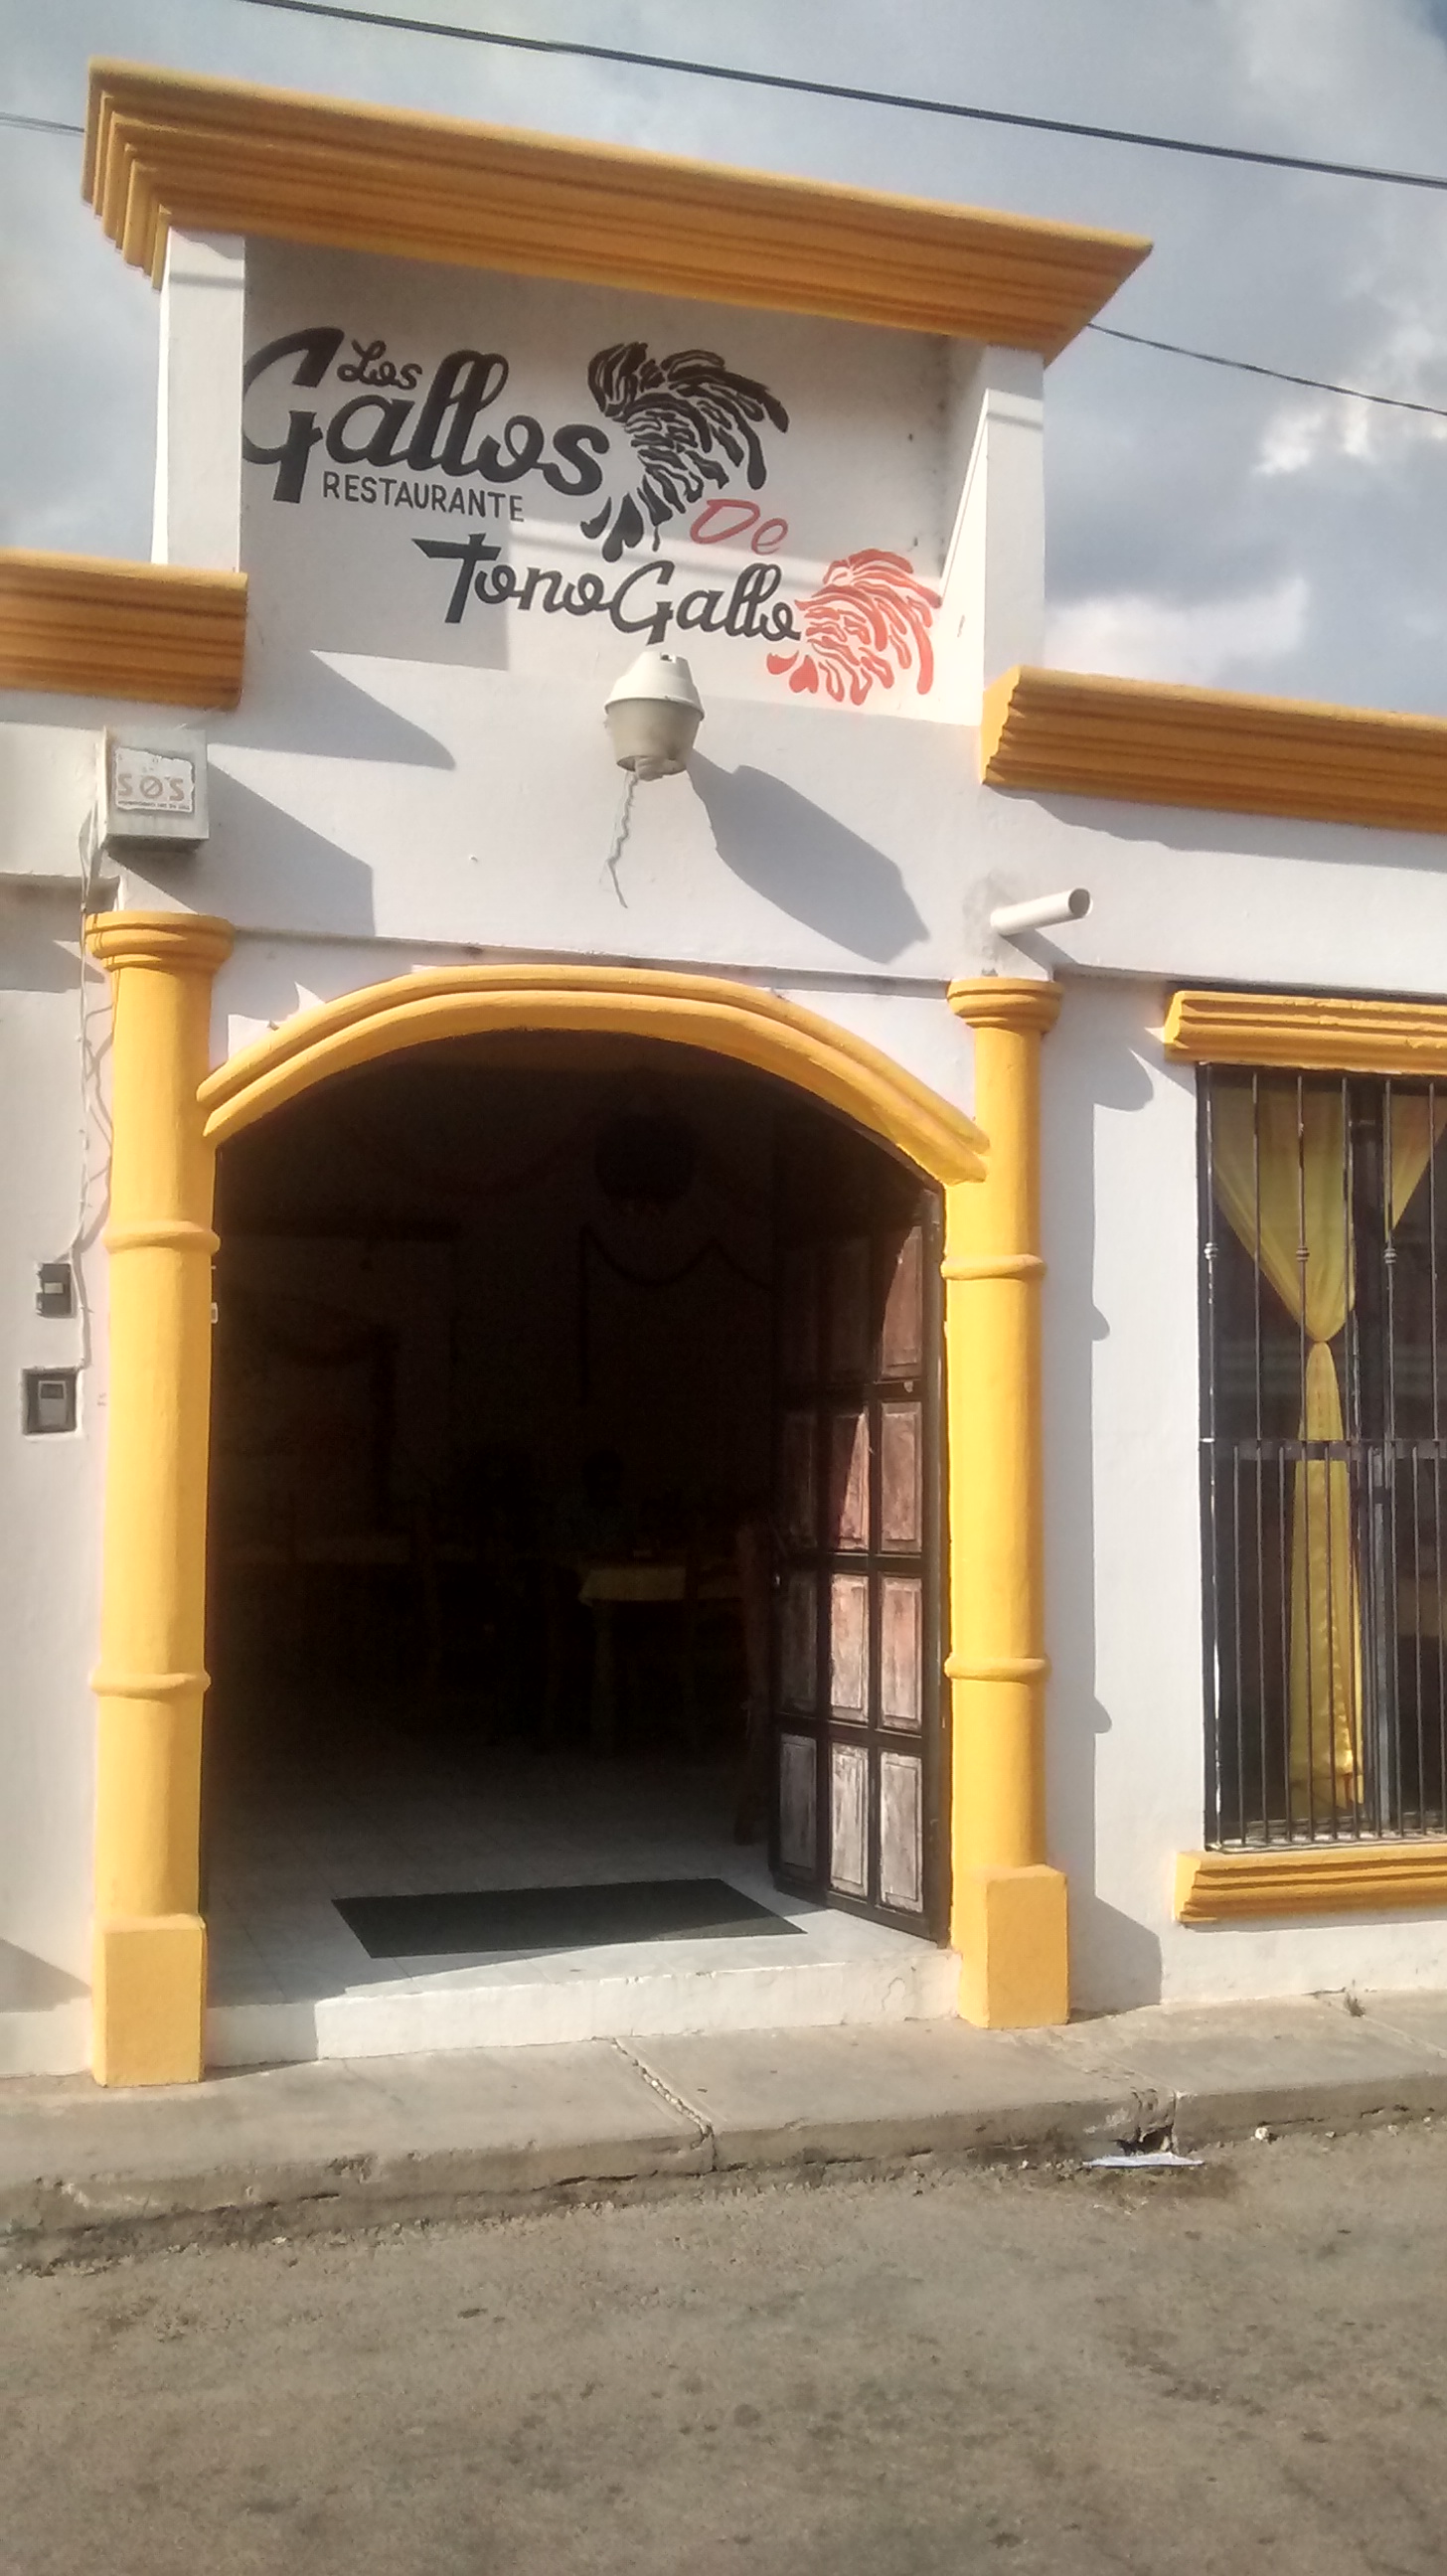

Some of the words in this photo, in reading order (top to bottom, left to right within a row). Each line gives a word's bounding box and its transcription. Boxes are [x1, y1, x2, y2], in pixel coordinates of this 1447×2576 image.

[336, 339, 423, 391] Los
[241, 326, 610, 504] Gallos
[322, 470, 525, 523] RESTAURANTE
[690, 498, 788, 556] De
